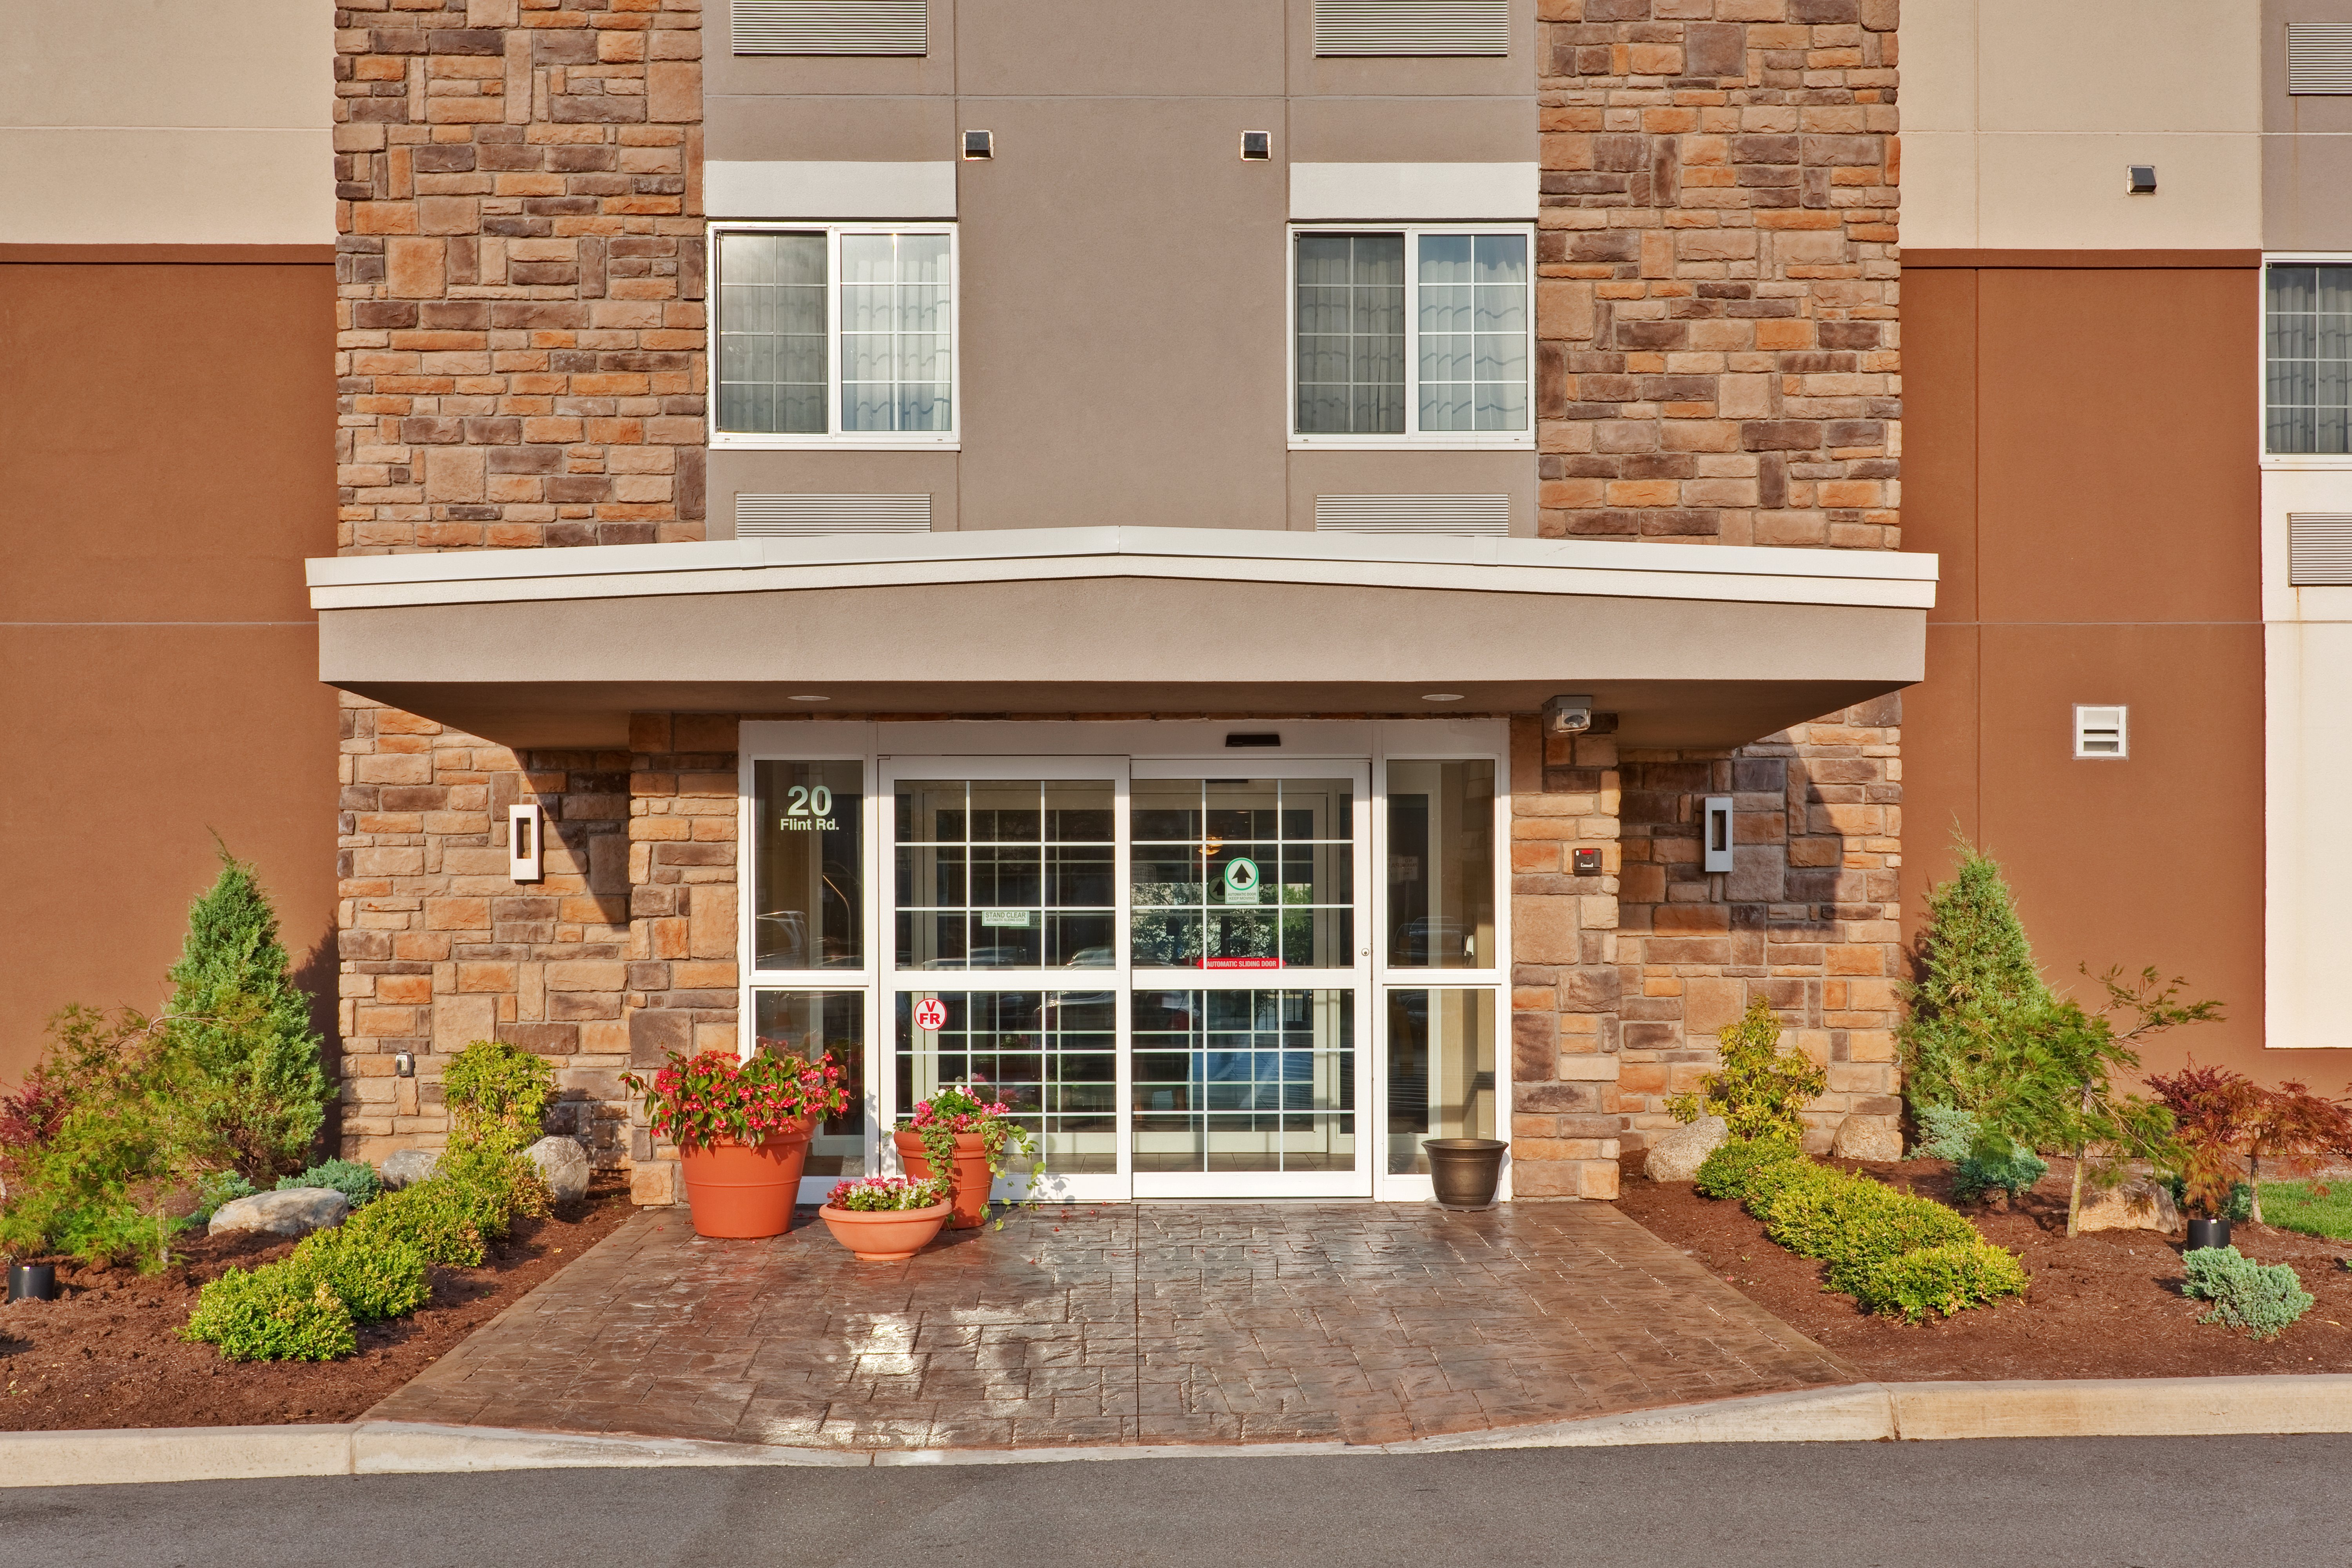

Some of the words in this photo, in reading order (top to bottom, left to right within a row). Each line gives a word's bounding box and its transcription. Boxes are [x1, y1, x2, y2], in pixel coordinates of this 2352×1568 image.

[788, 785, 832, 816] 20
[780, 818, 812, 830] Flint
[816, 818, 839, 830] Rd.
[925, 1001, 936, 1012] V
[920, 1013, 940, 1024] FR
